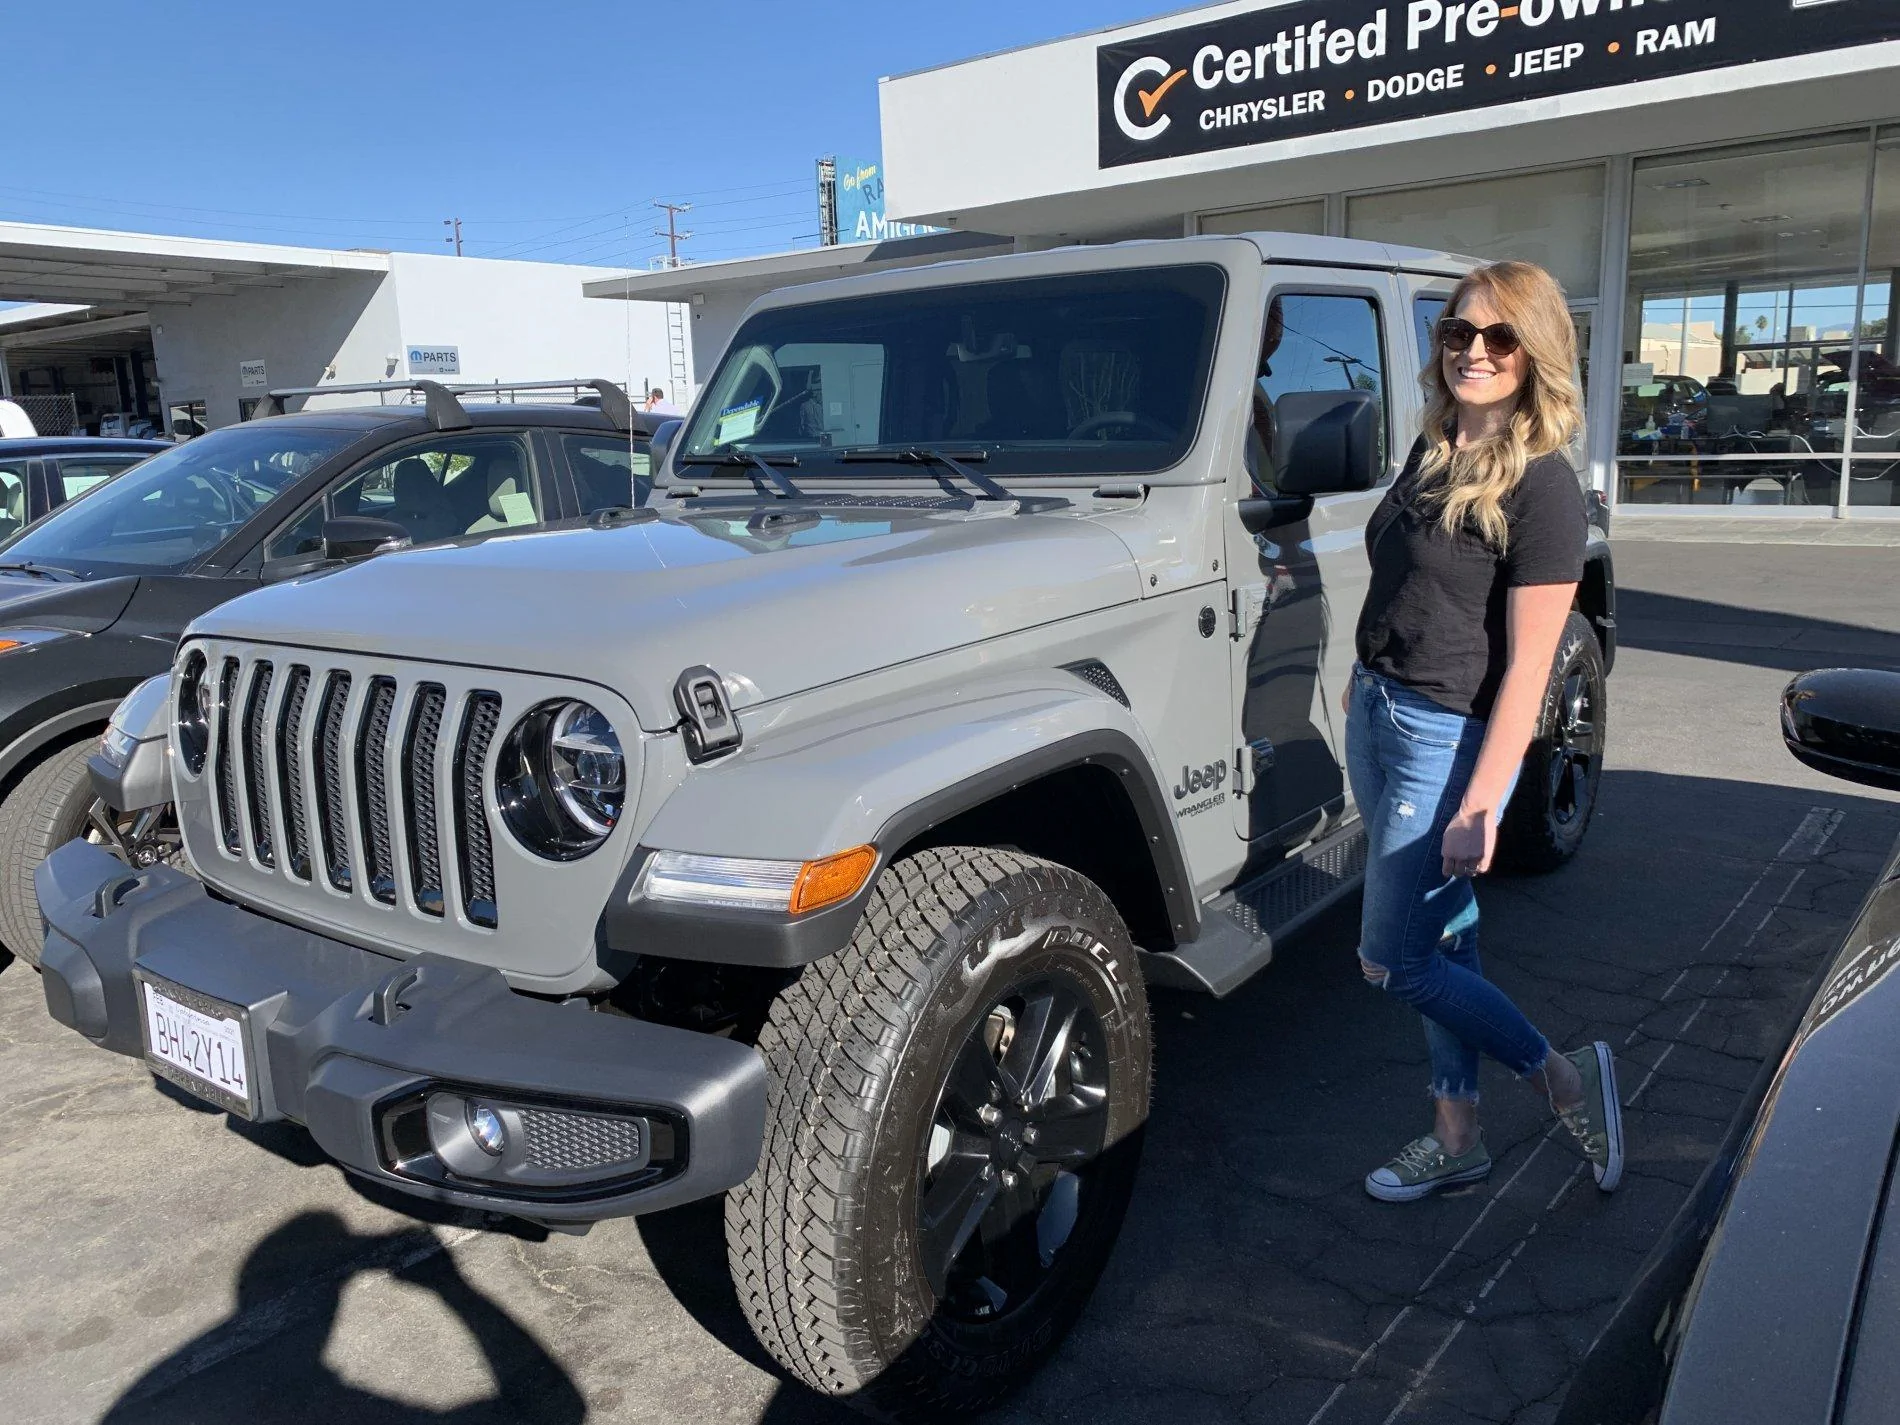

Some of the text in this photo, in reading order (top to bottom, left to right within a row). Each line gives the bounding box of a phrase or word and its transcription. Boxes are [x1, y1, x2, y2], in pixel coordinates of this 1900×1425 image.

[1192, 0, 1669, 90] Certifed Pre-ow
[1199, 17, 1716, 130] CHRYSLER DODGE JEEP RAM
[855, 210, 937, 240] AMIG
[423, 351, 457, 363] PARTS
[1173, 758, 1227, 800] Jeep
[1175, 792, 1225, 819] WRANGLER
[155, 1011, 244, 1090] BH42Y14
